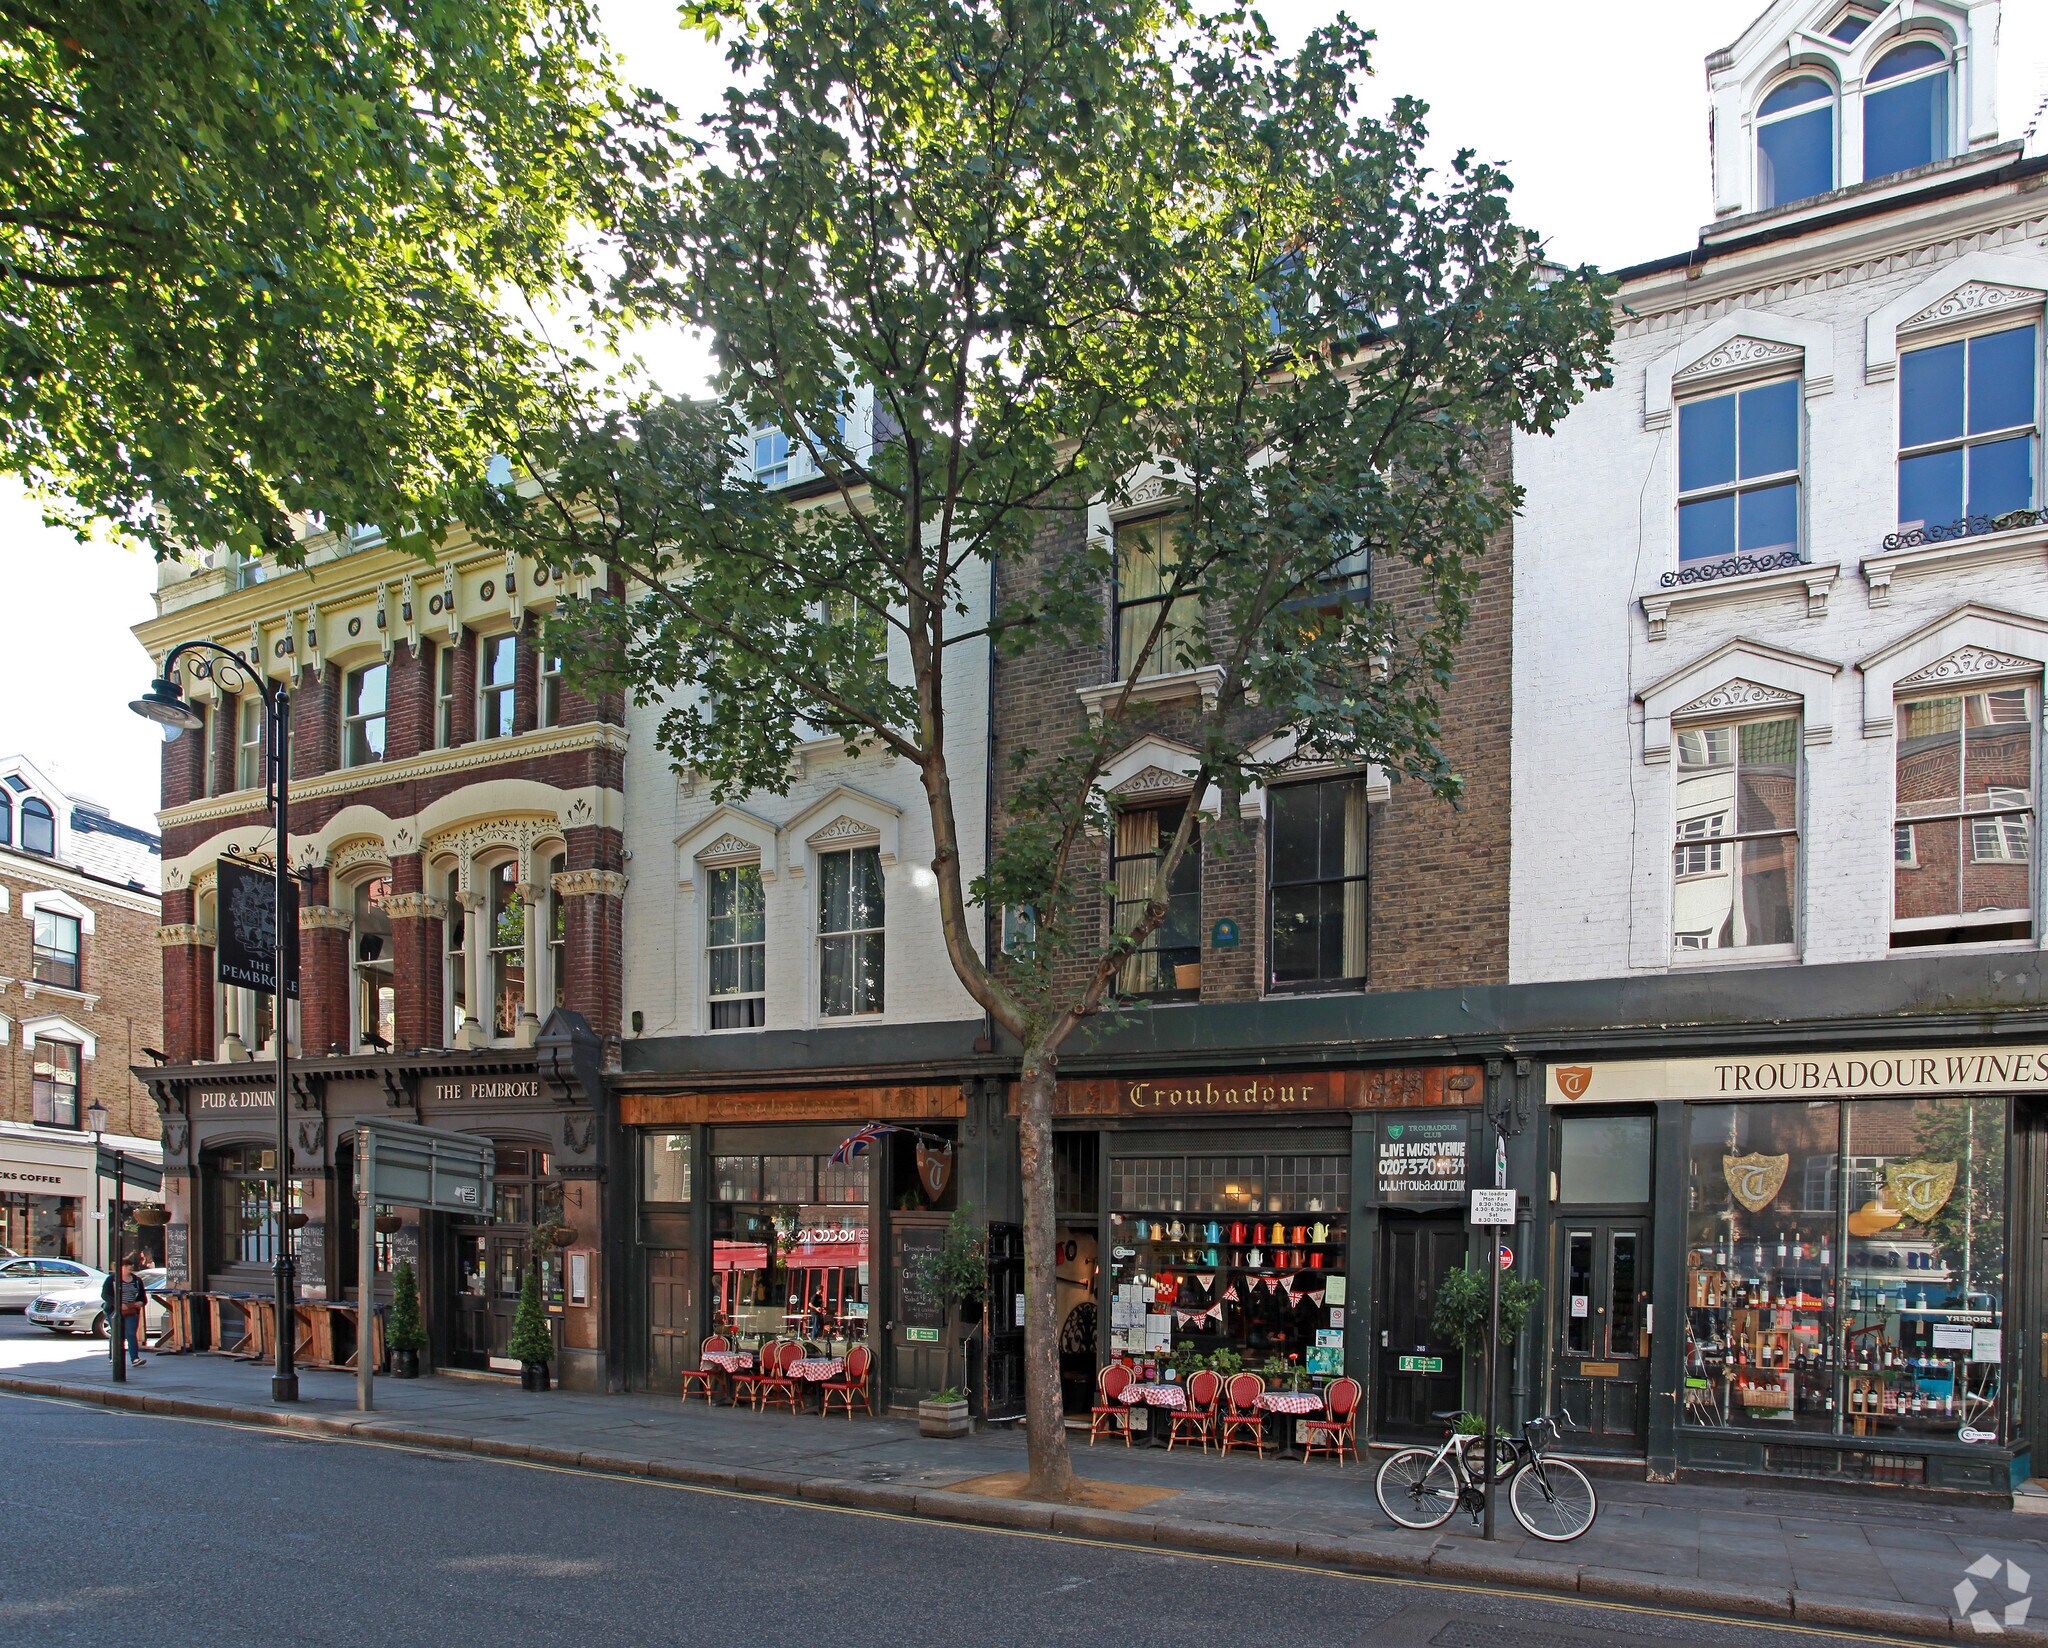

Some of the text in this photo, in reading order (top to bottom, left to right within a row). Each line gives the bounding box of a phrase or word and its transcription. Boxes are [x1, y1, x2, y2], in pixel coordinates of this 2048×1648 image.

[249, 960, 271, 973] THE
[223, 964, 298, 993] PEMBROE
[1714, 1053, 2048, 1092] TROUBADOUR WINES
[436, 1081, 538, 1099] THE PEMBROKE
[1129, 1080, 1314, 1108] Troubadour
[201, 1090, 276, 1109] PUB & DININ
[1408, 1124, 1457, 1132] TROUBADOUR
[1380, 1142, 1466, 1157] LIVE MUSIC VENUE
[1379, 1159, 1407, 1175] 0207
[21, 1173, 61, 1184] COFFEE
